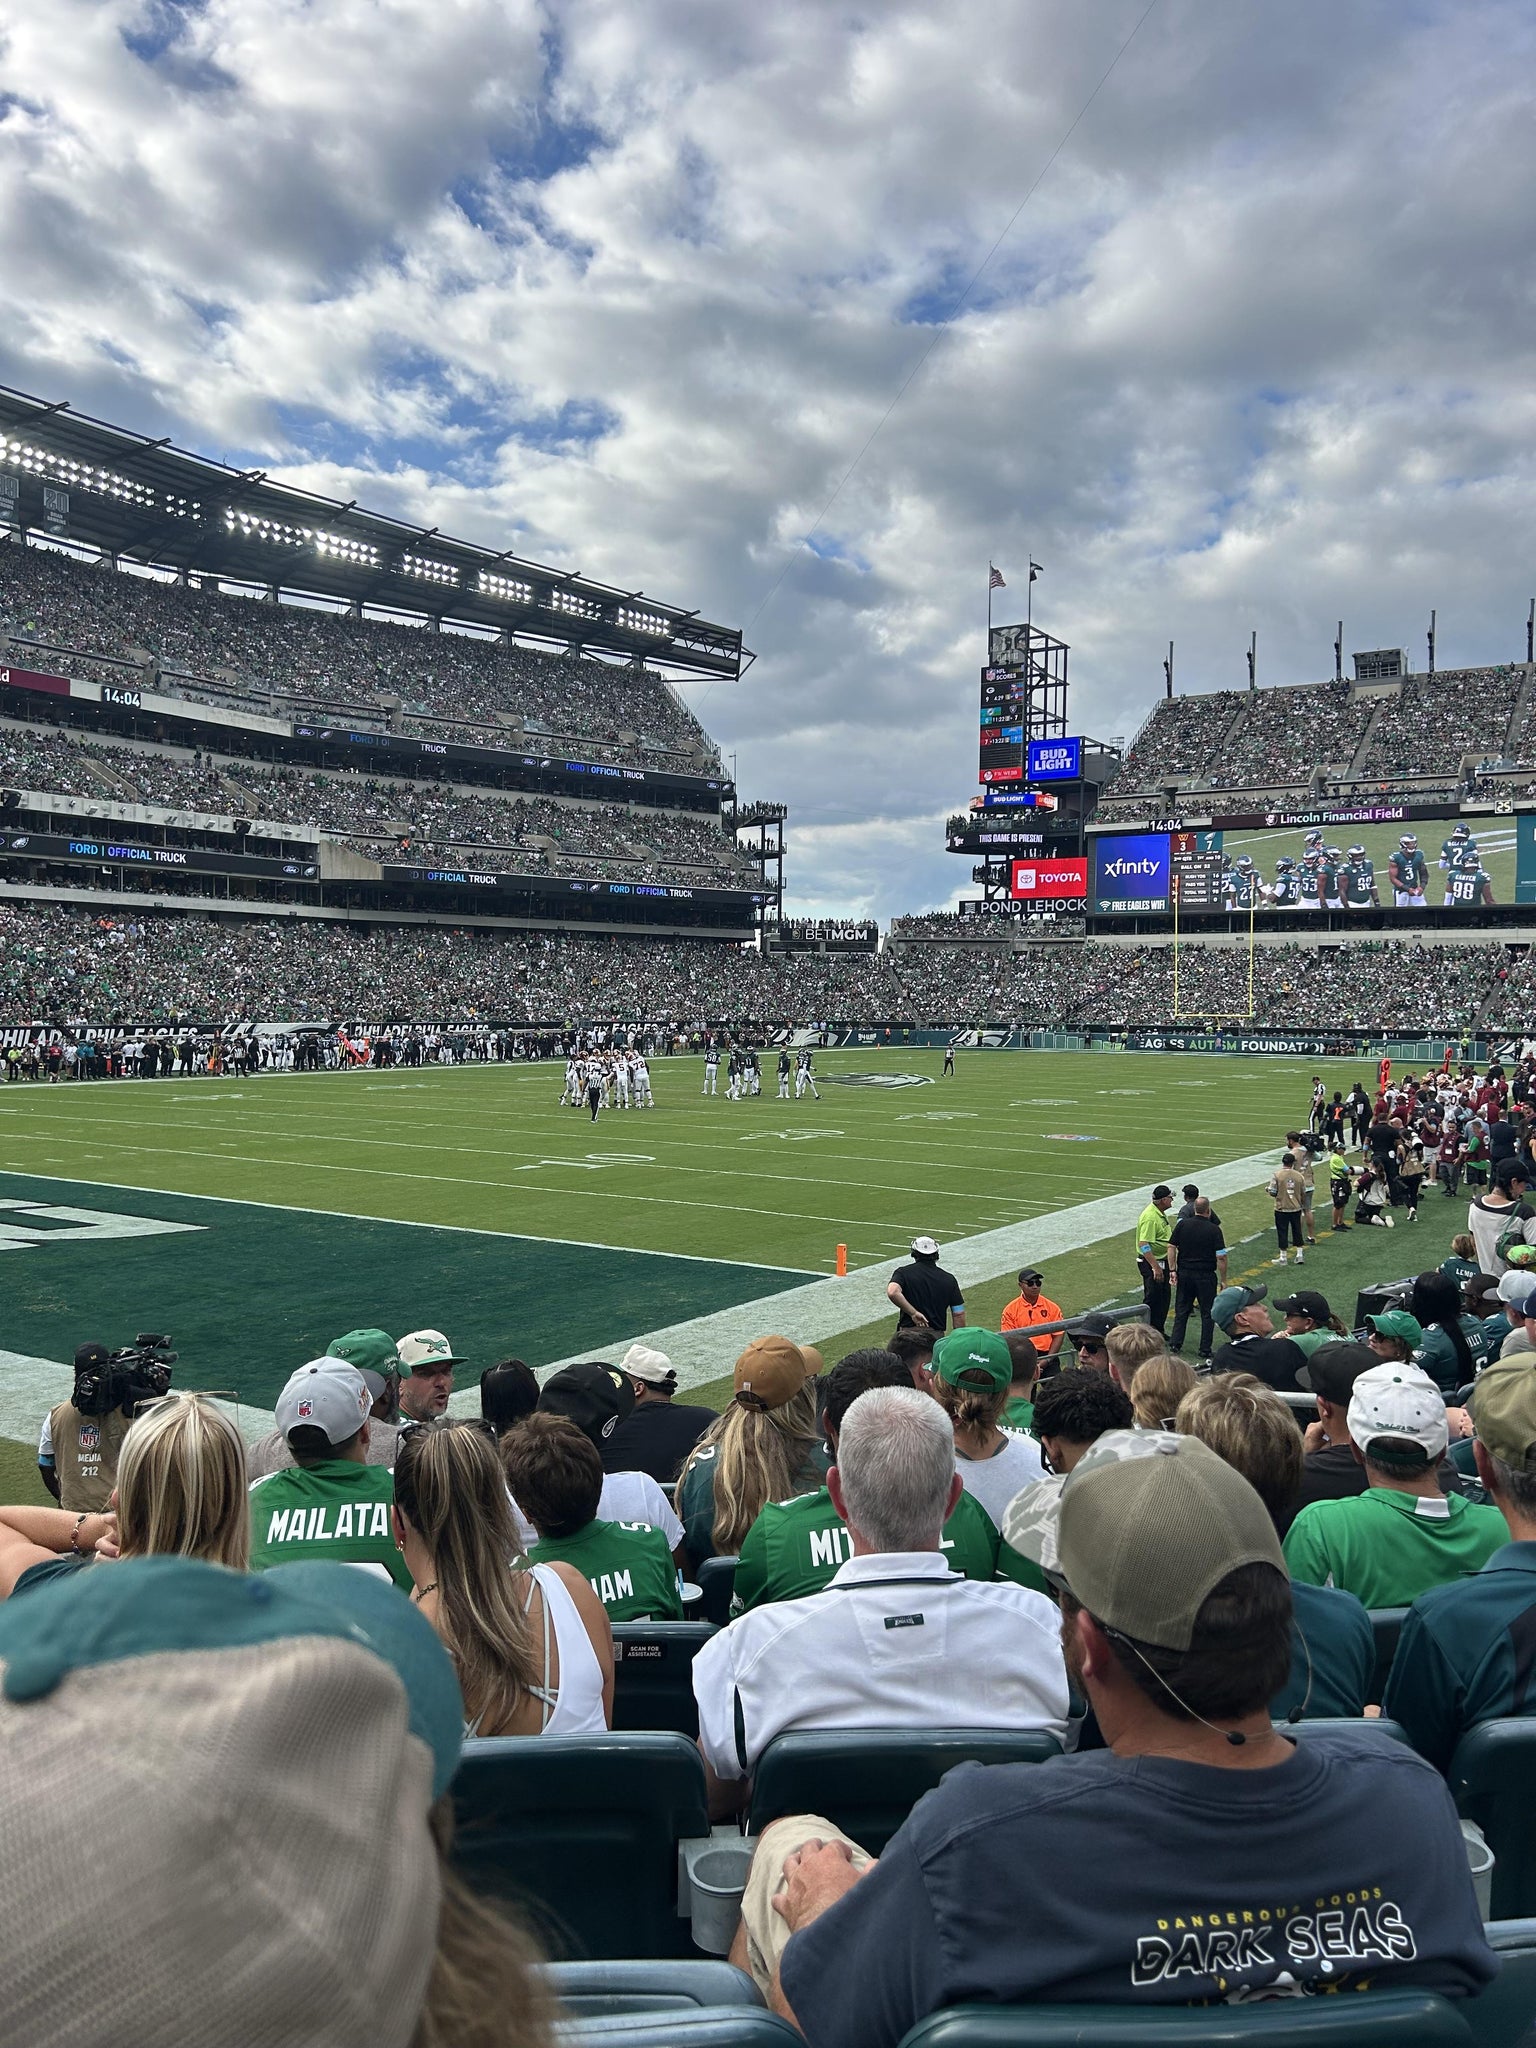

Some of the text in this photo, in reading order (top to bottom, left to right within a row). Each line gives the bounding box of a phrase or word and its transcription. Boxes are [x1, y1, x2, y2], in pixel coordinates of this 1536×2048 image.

[104, 688, 140, 708] 14:04
[350, 734, 373, 745] FORD
[420, 743, 447, 754] TRUCK
[1040, 748, 1068, 760] BUD
[1034, 757, 1073, 771] LIGHT
[566, 763, 645, 780] FORD OFFICIAL TRUCK
[1497, 801, 1511, 812] 25
[1280, 807, 1403, 824] Lincoln Financial Field
[1150, 820, 1182, 831] 14:04
[979, 834, 1043, 843] THIS GAME IS PRESENT
[1180, 840, 1213, 851] 3 7
[69, 842, 186, 864] FORD OFFICIAL TRUCK
[1104, 858, 1160, 878] xfinity
[1404, 867, 1414, 880] 3
[427, 871, 467, 883] OFFICIAL
[468, 874, 497, 885] TRUCK
[1039, 872, 1082, 883] TOYOTA
[609, 884, 693, 898] FORD OFFICIAL TRUCK
[1303, 877, 1318, 892] 53
[1452, 881, 1475, 900] 98
[980, 899, 1088, 914] POND LEHOCK
[1112, 901, 1126, 911] FREE
[1127, 900, 1150, 910] EAGLES
[1151, 900, 1166, 910] WIFI
[805, 928, 868, 940] BETMGM
[1189, 1039, 1237, 1051] AUTSM
[78, 1453, 102, 1463] MEDIA
[81, 1466, 99, 1477] 212
[266, 1502, 389, 1545] MAILATA
[1315, 1887, 1382, 1908] GOODS
[1131, 1902, 1417, 1986] DARK SEAS
